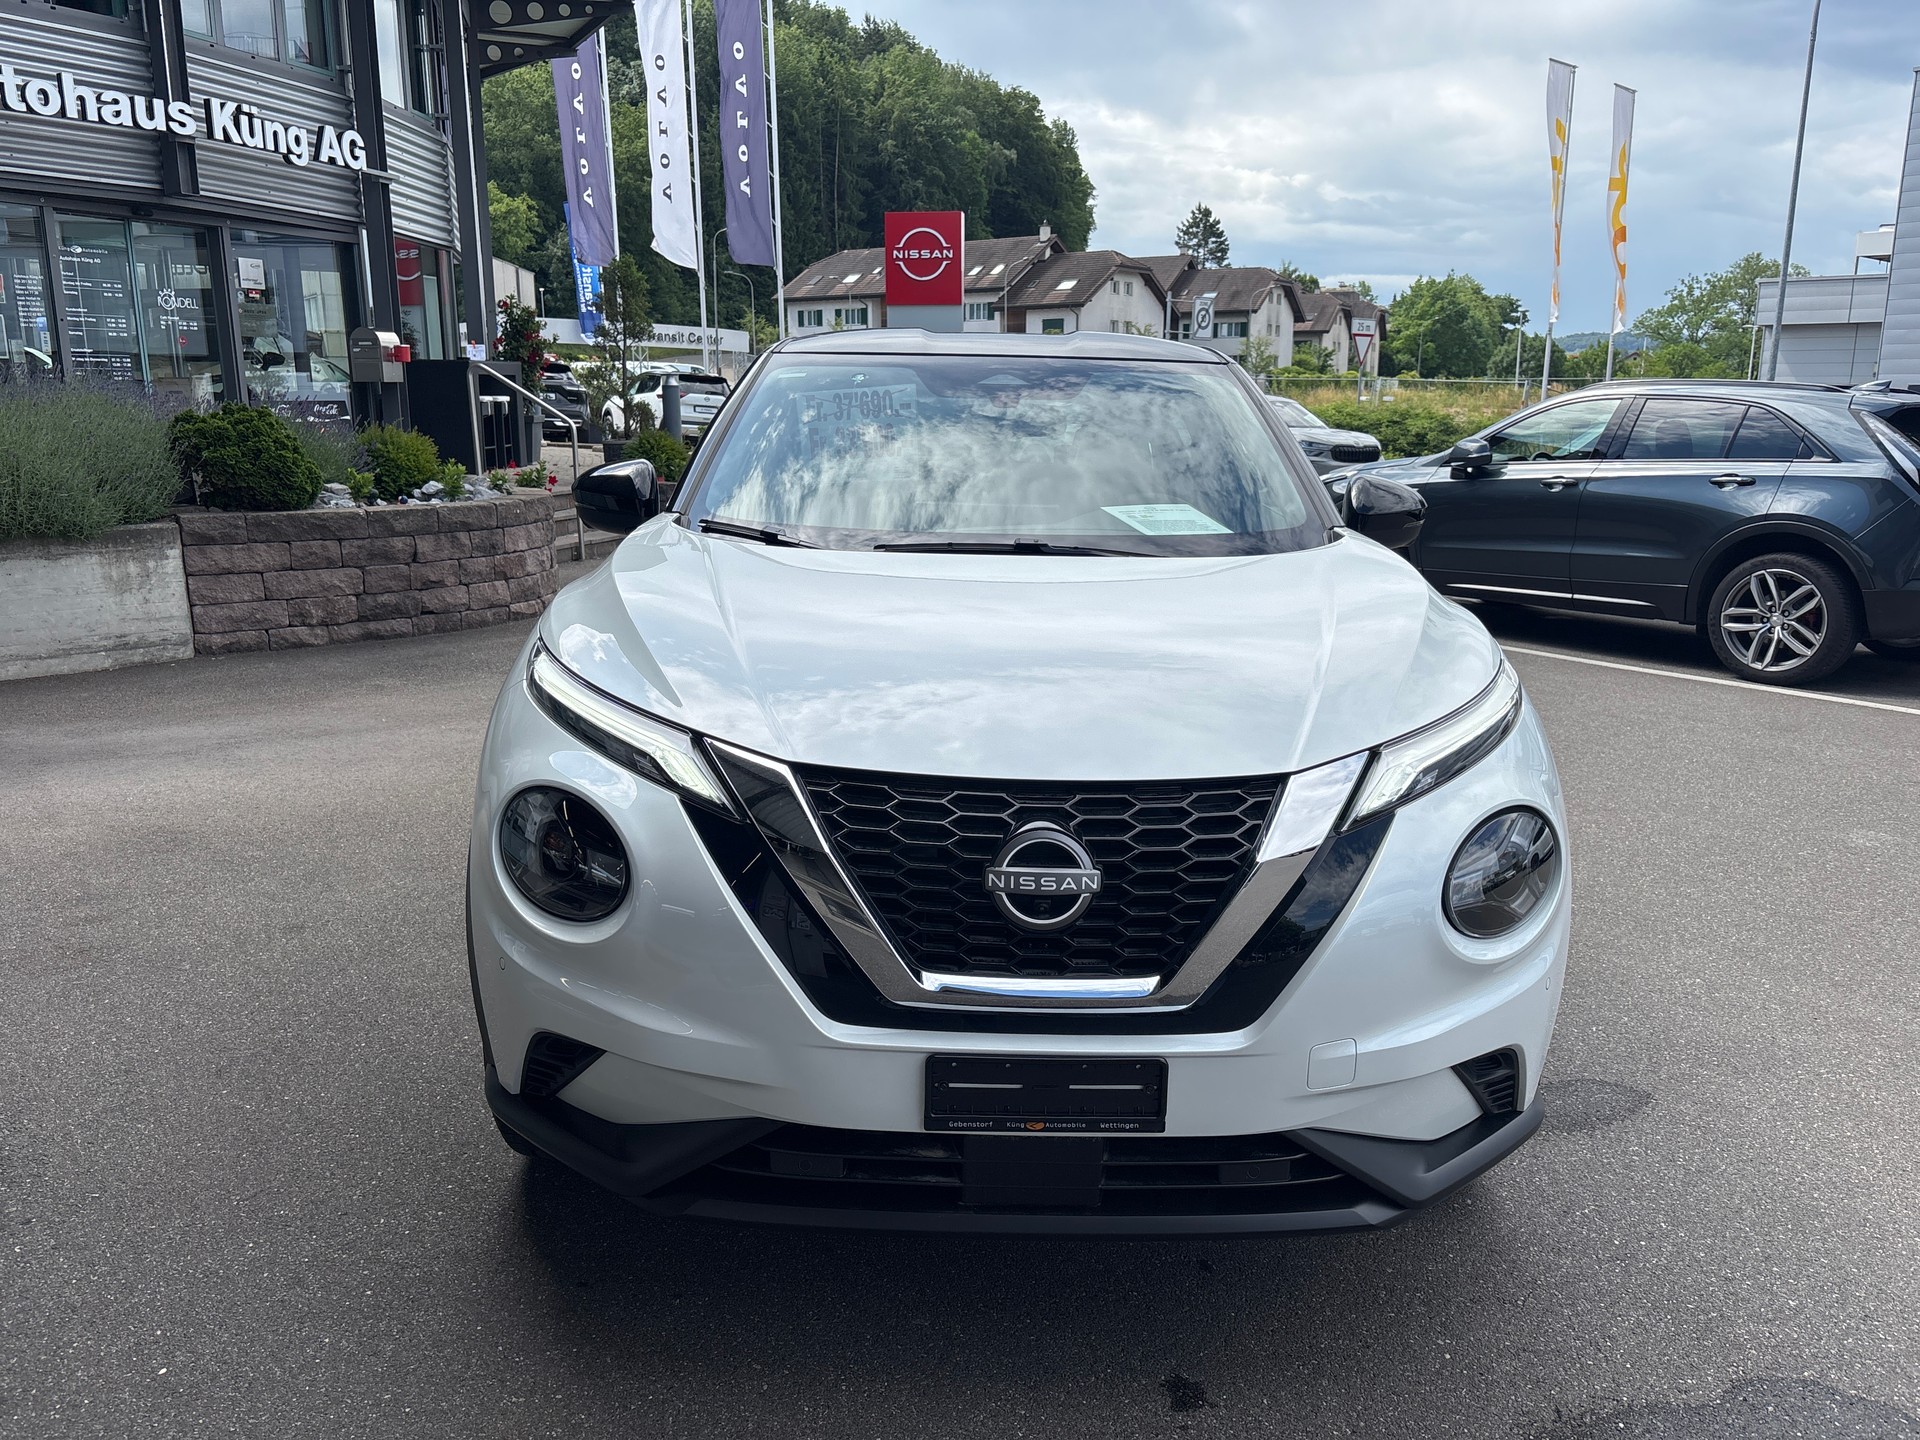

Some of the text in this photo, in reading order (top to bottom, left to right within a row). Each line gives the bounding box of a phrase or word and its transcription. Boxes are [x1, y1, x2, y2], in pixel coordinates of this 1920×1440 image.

[206, 97, 310, 167] Küng
[317, 125, 368, 171] AG
[892, 249, 954, 259] NISSAN
[157, 295, 199, 310] RONDELL
[1357, 322, 1365, 331] 25
[648, 331, 685, 344] ransit
[805, 394, 828, 422] Fr.
[988, 873, 1098, 890] NISSAN
[948, 1120, 1139, 1130] Gebenstorf Küng Automobile Wettingen
